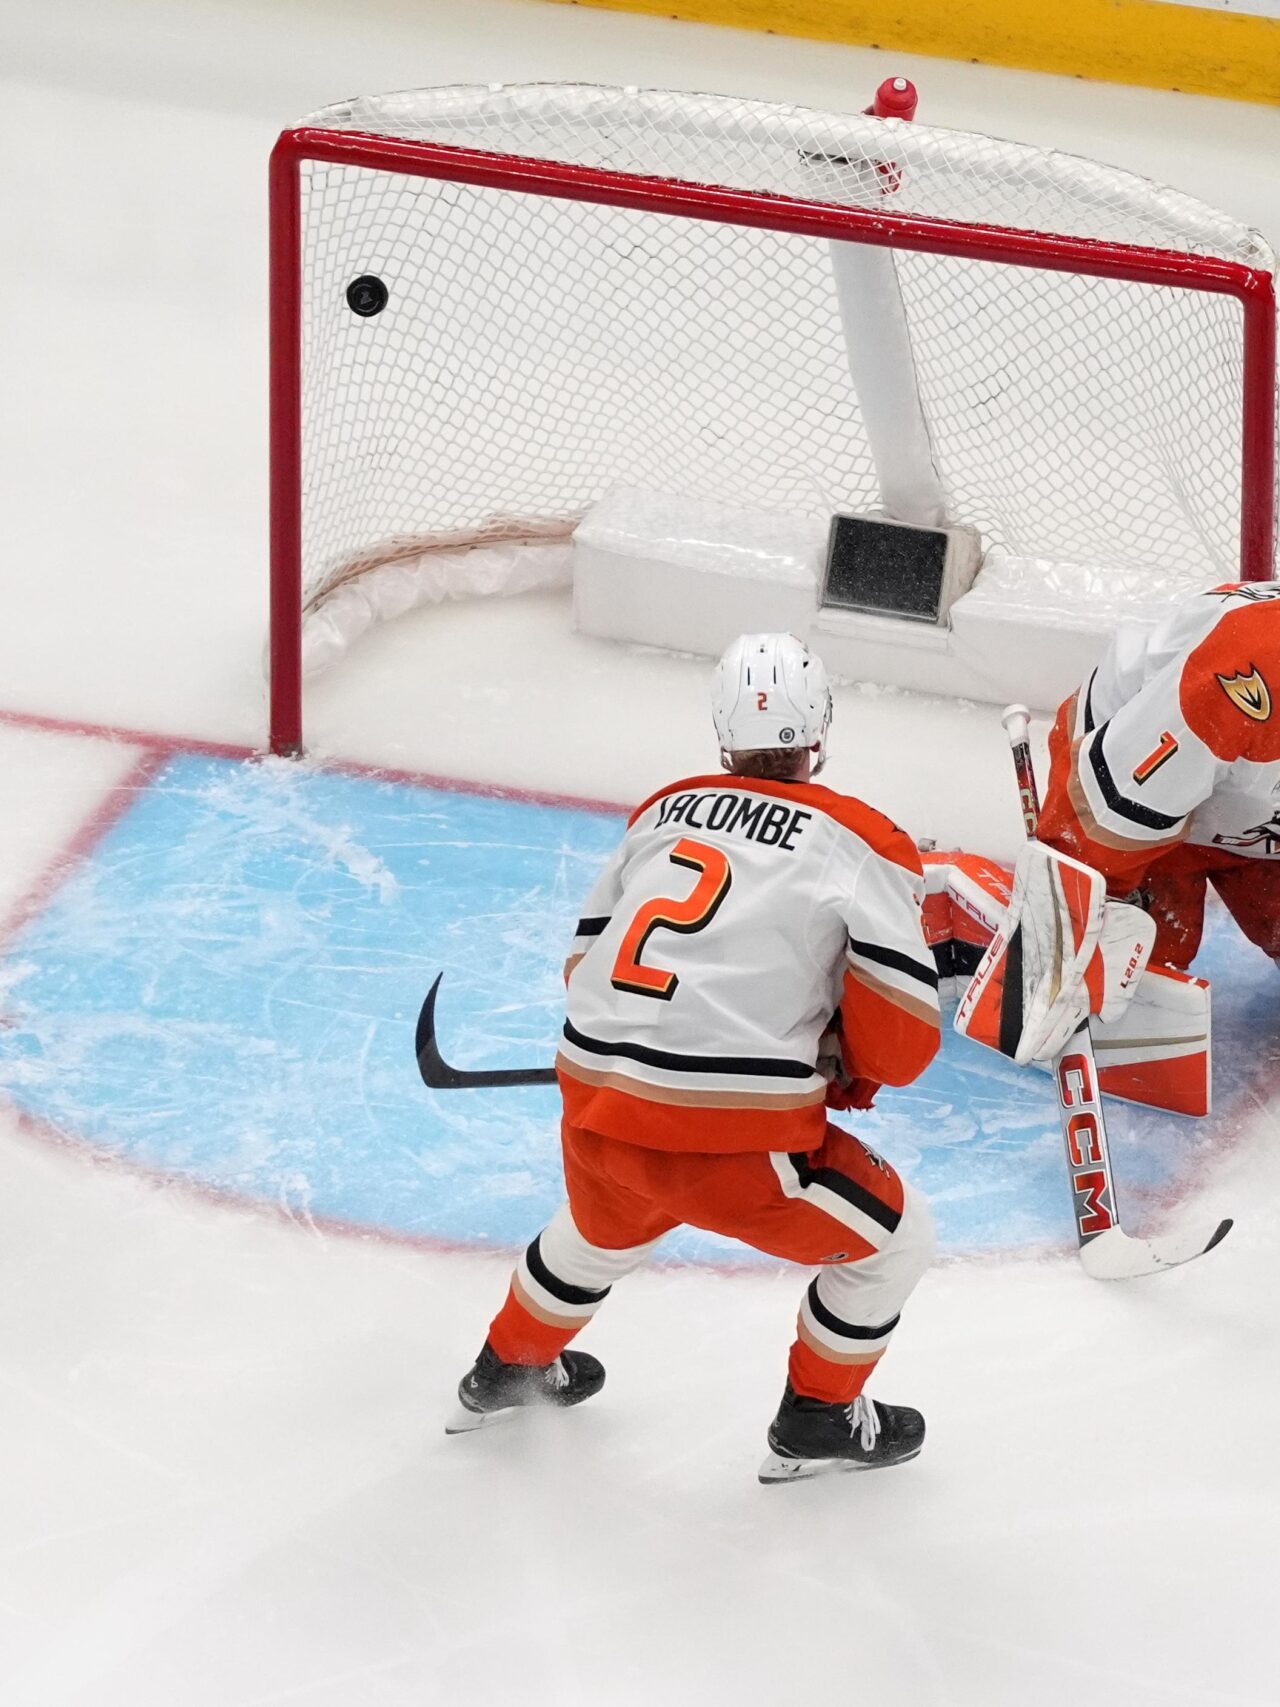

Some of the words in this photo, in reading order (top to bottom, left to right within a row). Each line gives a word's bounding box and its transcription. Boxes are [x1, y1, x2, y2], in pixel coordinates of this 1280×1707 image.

[757, 692, 768, 711] 2
[1132, 730, 1179, 787] 1
[654, 793, 812, 851] LACOMBE
[1020, 788, 1038, 835] CC
[610, 837, 733, 1001] 2
[947, 884, 1000, 932] TRU
[956, 933, 1004, 1025] TRUE
[1058, 1053, 1113, 1236] CCM
